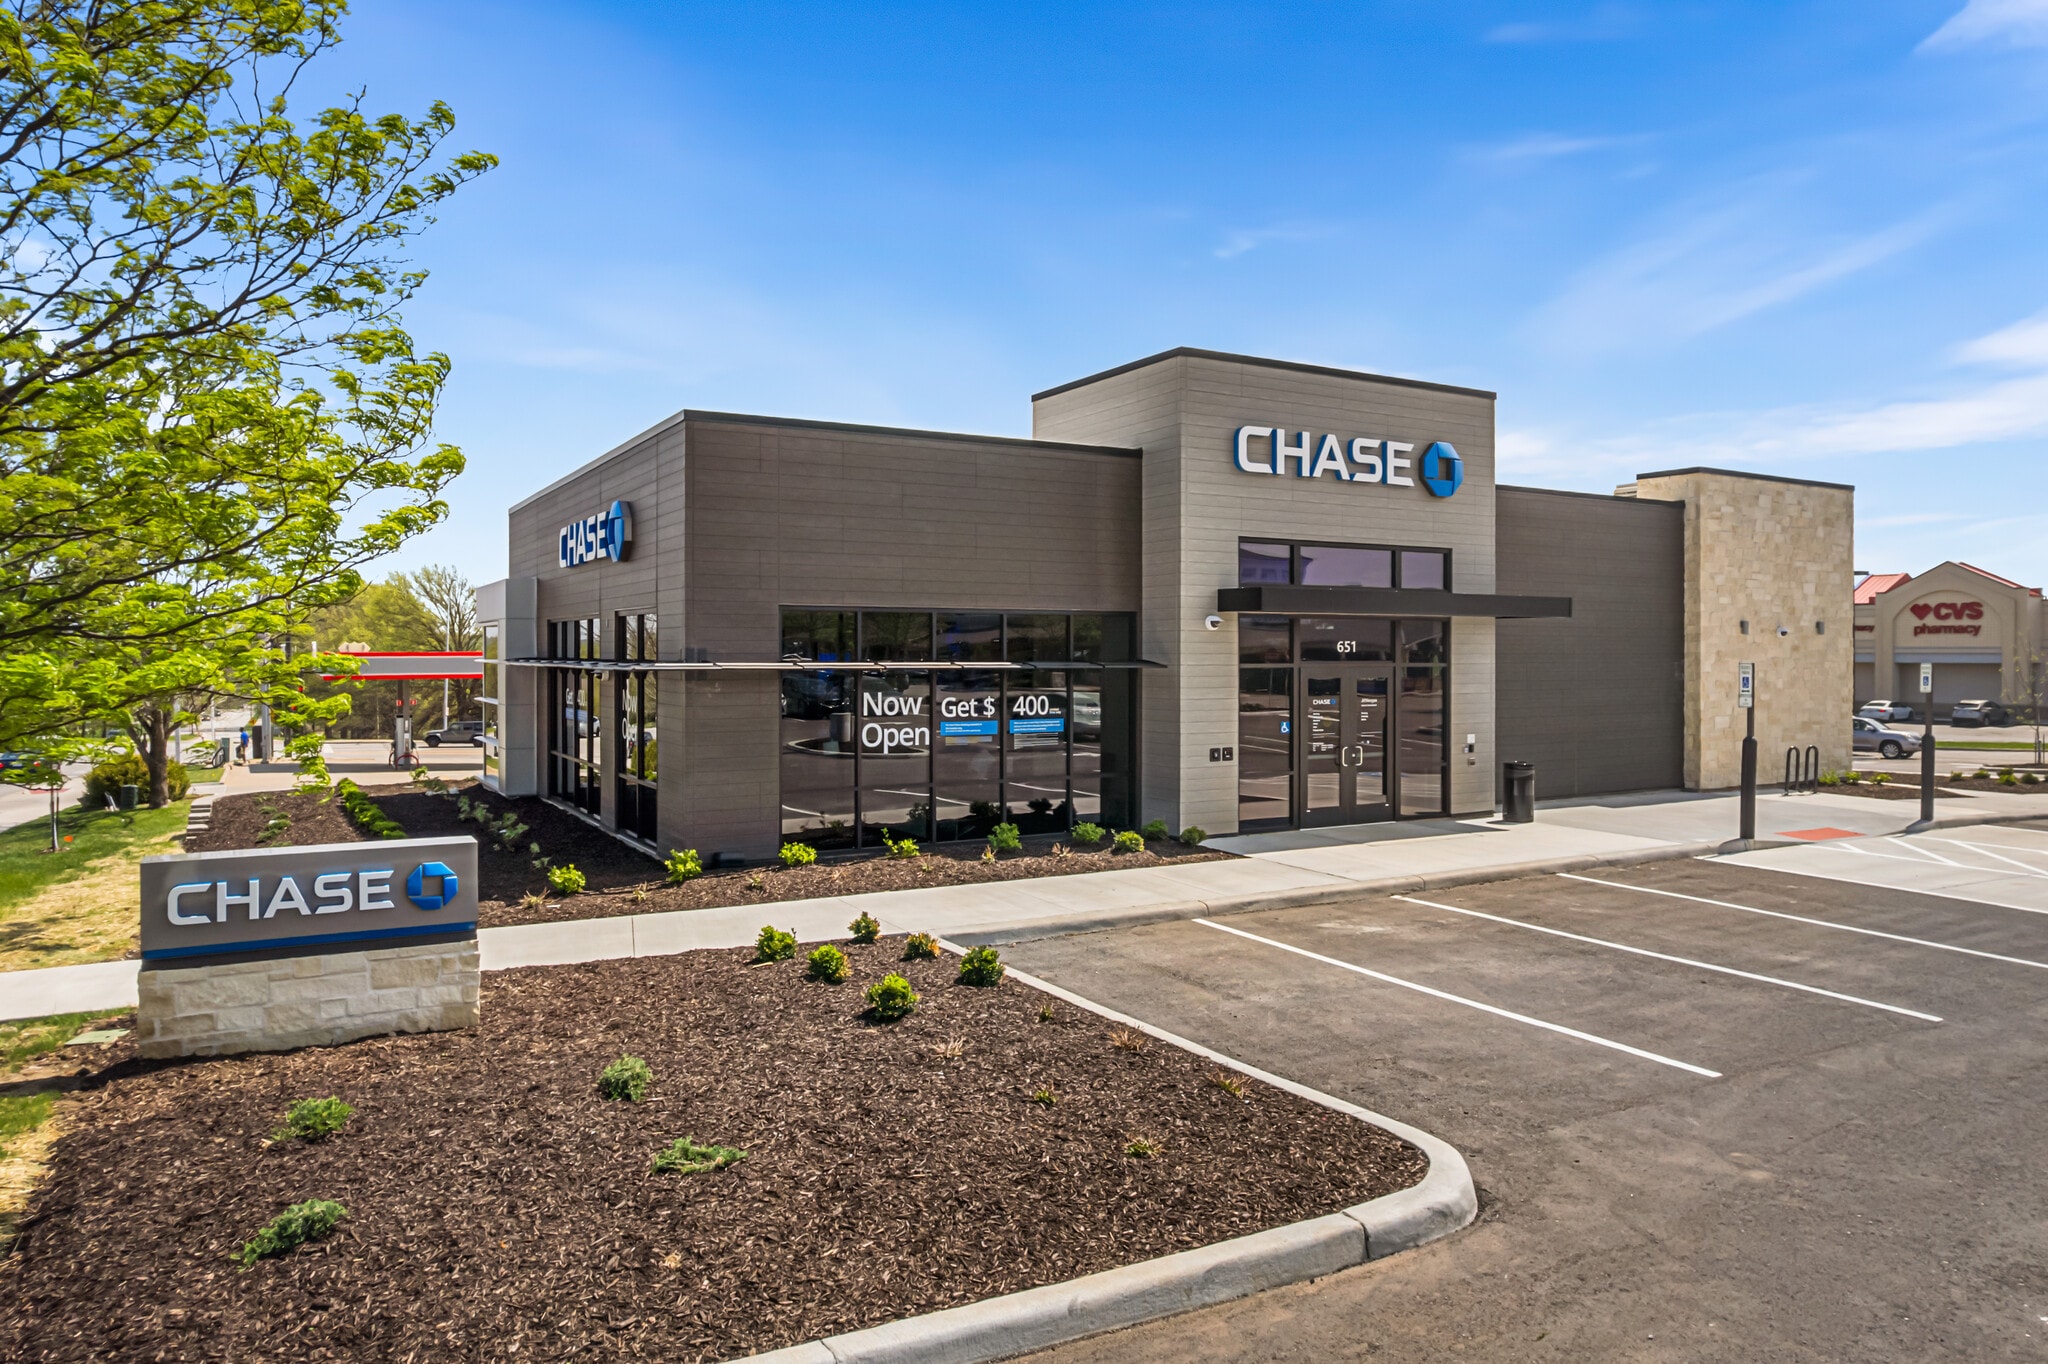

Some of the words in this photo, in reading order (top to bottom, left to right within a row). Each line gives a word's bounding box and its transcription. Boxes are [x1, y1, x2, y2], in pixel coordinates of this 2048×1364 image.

[1234, 425, 1415, 487] CHASE
[559, 511, 608, 568] CHASE
[1933, 602, 1984, 620] CVS
[1914, 623, 1982, 637] pharmacy
[1336, 640, 1356, 653] 651
[863, 692, 923, 716] Now
[941, 697, 978, 717] Get
[983, 695, 996, 718] $
[1012, 695, 1049, 716] 400
[862, 723, 930, 754] Open
[167, 870, 395, 926] CHASE
